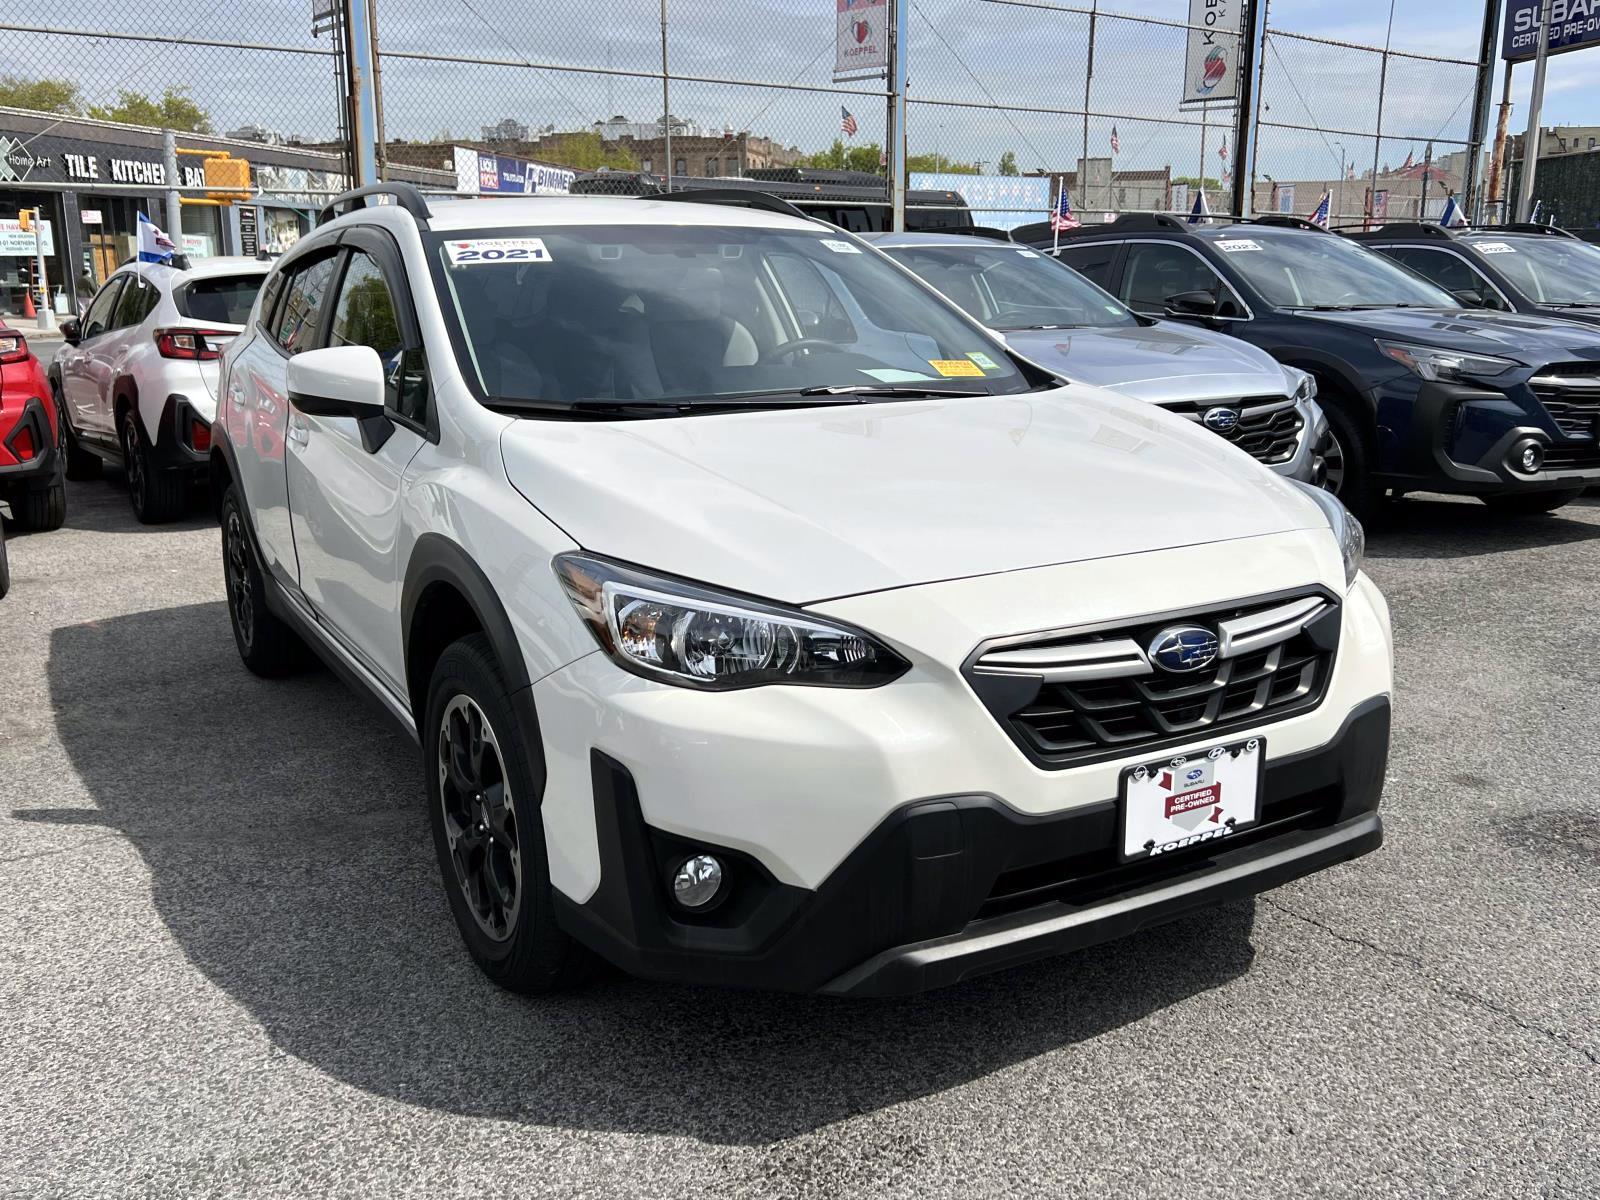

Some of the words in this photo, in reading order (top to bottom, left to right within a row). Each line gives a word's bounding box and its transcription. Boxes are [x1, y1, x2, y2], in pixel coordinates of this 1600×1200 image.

[1512, 26, 1560, 48] CERTIED
[844, 45, 878, 57] KOEPPEL
[8, 153, 33, 166] Home
[36, 155, 52, 168] Art
[64, 153, 99, 179] TILE
[184, 166, 205, 187] BAT
[476, 239, 538, 247] KOEPPEL
[456, 248, 543, 262] 2021
[1184, 779, 1205, 788] SUBARU
[1174, 788, 1212, 804] CERTIFIED
[1170, 796, 1215, 813] PRE-OWNED
[1149, 826, 1234, 856] KOEPPEL
